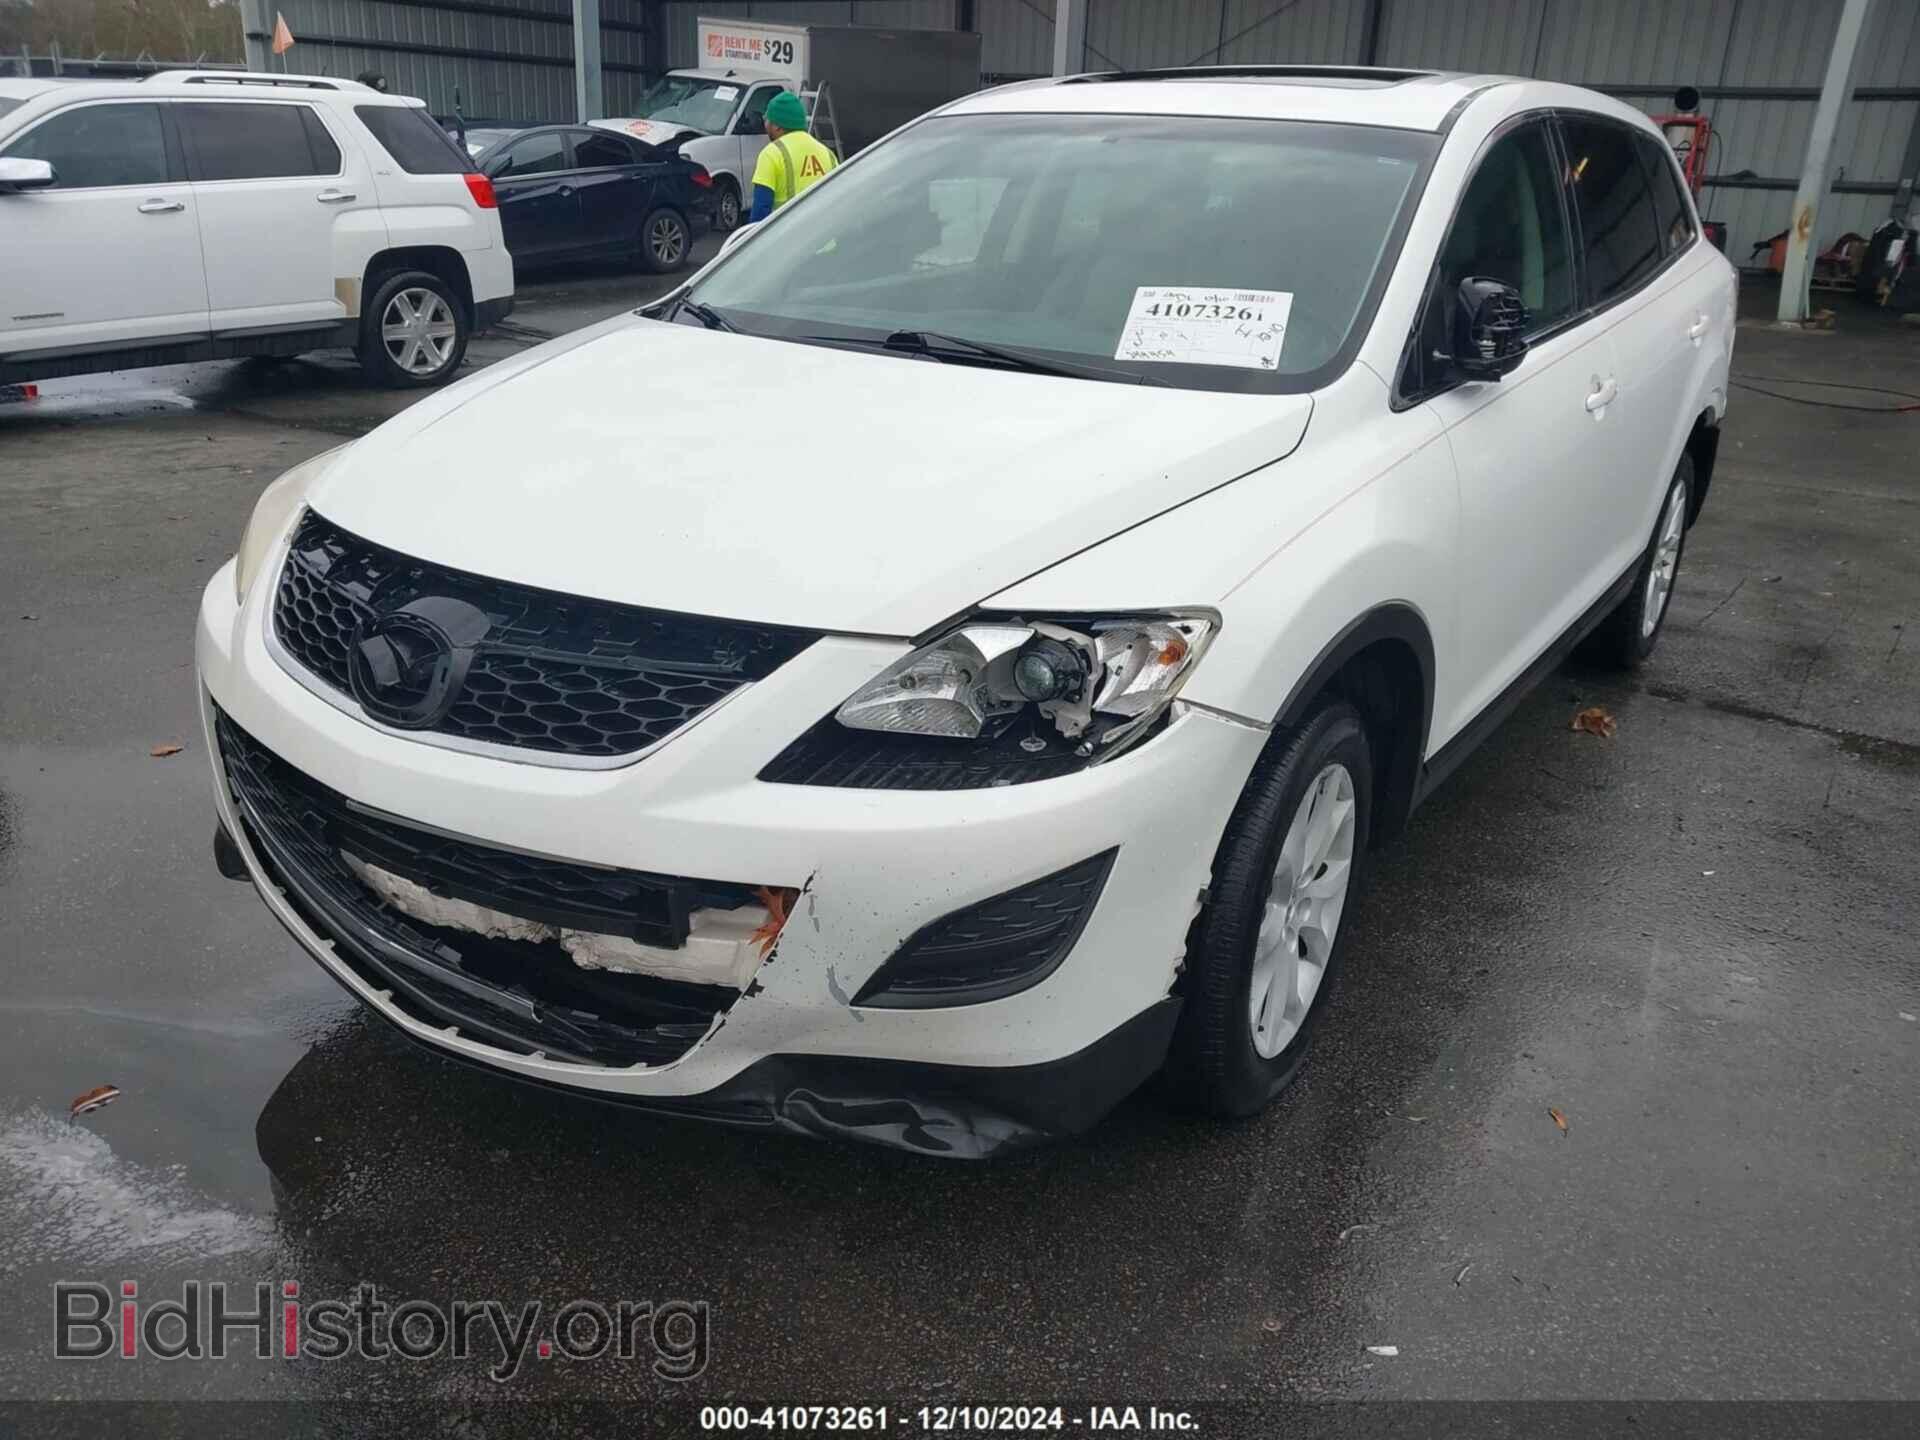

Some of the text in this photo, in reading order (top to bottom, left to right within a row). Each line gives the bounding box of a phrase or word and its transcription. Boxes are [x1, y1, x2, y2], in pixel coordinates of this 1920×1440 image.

[725, 36, 746, 50] RENT
[749, 39, 762, 51] ME
[764, 39, 794, 64] $29
[1145, 303, 1264, 322] 41073261
